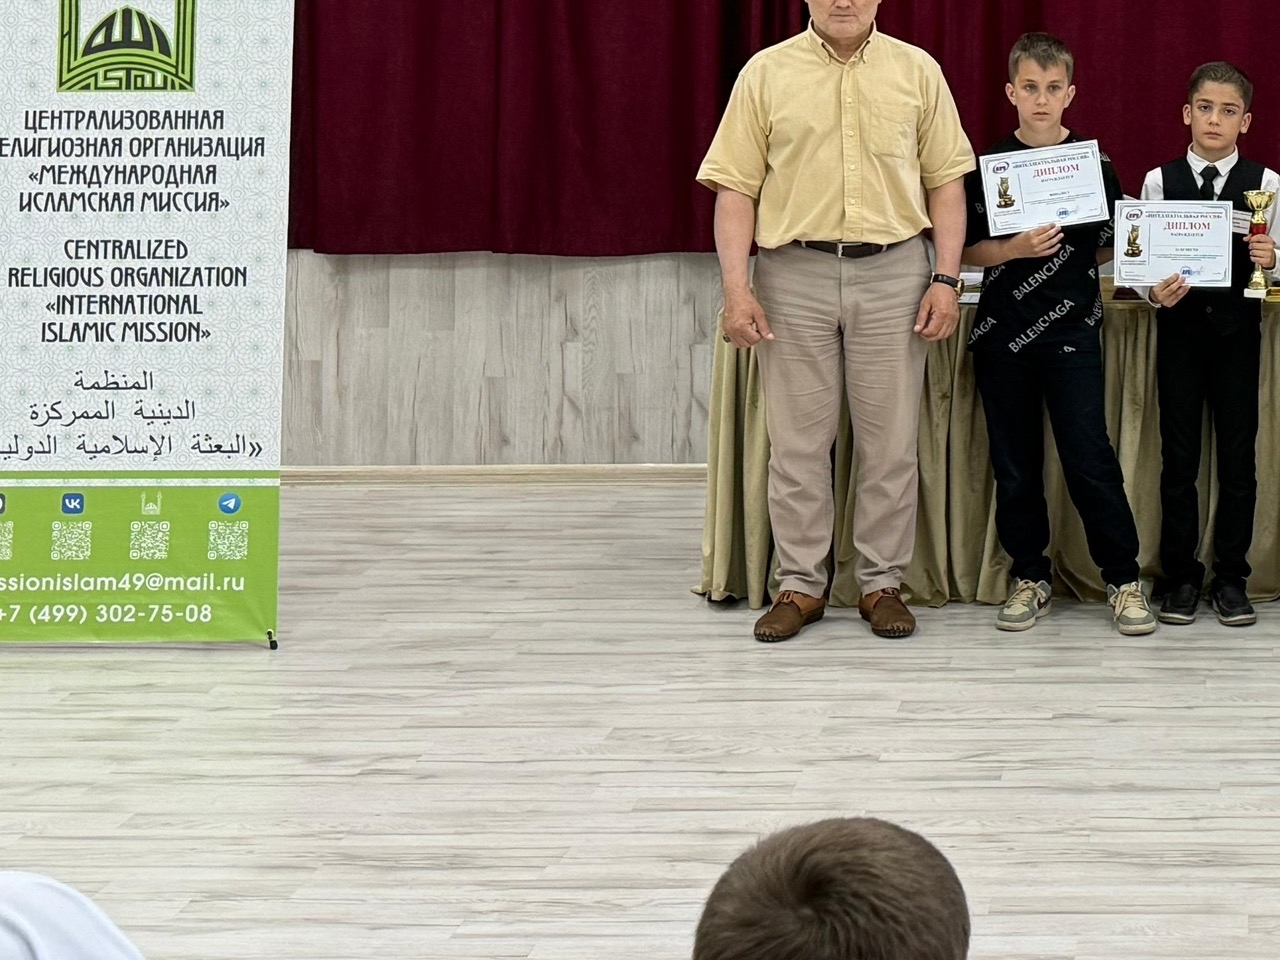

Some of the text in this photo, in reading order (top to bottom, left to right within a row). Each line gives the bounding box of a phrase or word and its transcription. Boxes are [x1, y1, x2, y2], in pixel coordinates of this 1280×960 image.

[24, 110, 224, 134] ЦЕНТРАЛИЗОВАННАЯ
[0, 137, 265, 161] ЕЛИГИОЗНАЯ ОРГАНИЗАЦИЯ
[28, 164, 217, 189] «МЕЖДУНАРОДНАЯ
[1033, 163, 1080, 179] ДИПЛОМ
[19, 192, 230, 213] ИСЛАМСКАЯ МИССИЯ»
[1163, 221, 1211, 231] ДИПЛОМ
[63, 239, 189, 260] CENTRALIZED
[8, 267, 247, 288] RELIGIOUS ORGANIZATION
[1012, 244, 1075, 300] BALENCIAGA
[45, 294, 203, 315] «INTERNATIONAL
[41, 322, 211, 343] ISLAMIC MISSION»
[1008, 299, 1075, 353] BALENCIAGA
[74, 370, 153, 391] المنظمة
[29, 399, 196, 427] الدينية الممركزة
[0, 434, 57, 461] الدولي
[76, 434, 172, 462] الإسلامية
[0, 573, 245, 592] ssionislam49@mail.ru
[29, 604, 87, 625] (499)
[95, 604, 213, 623] 302-75-08
